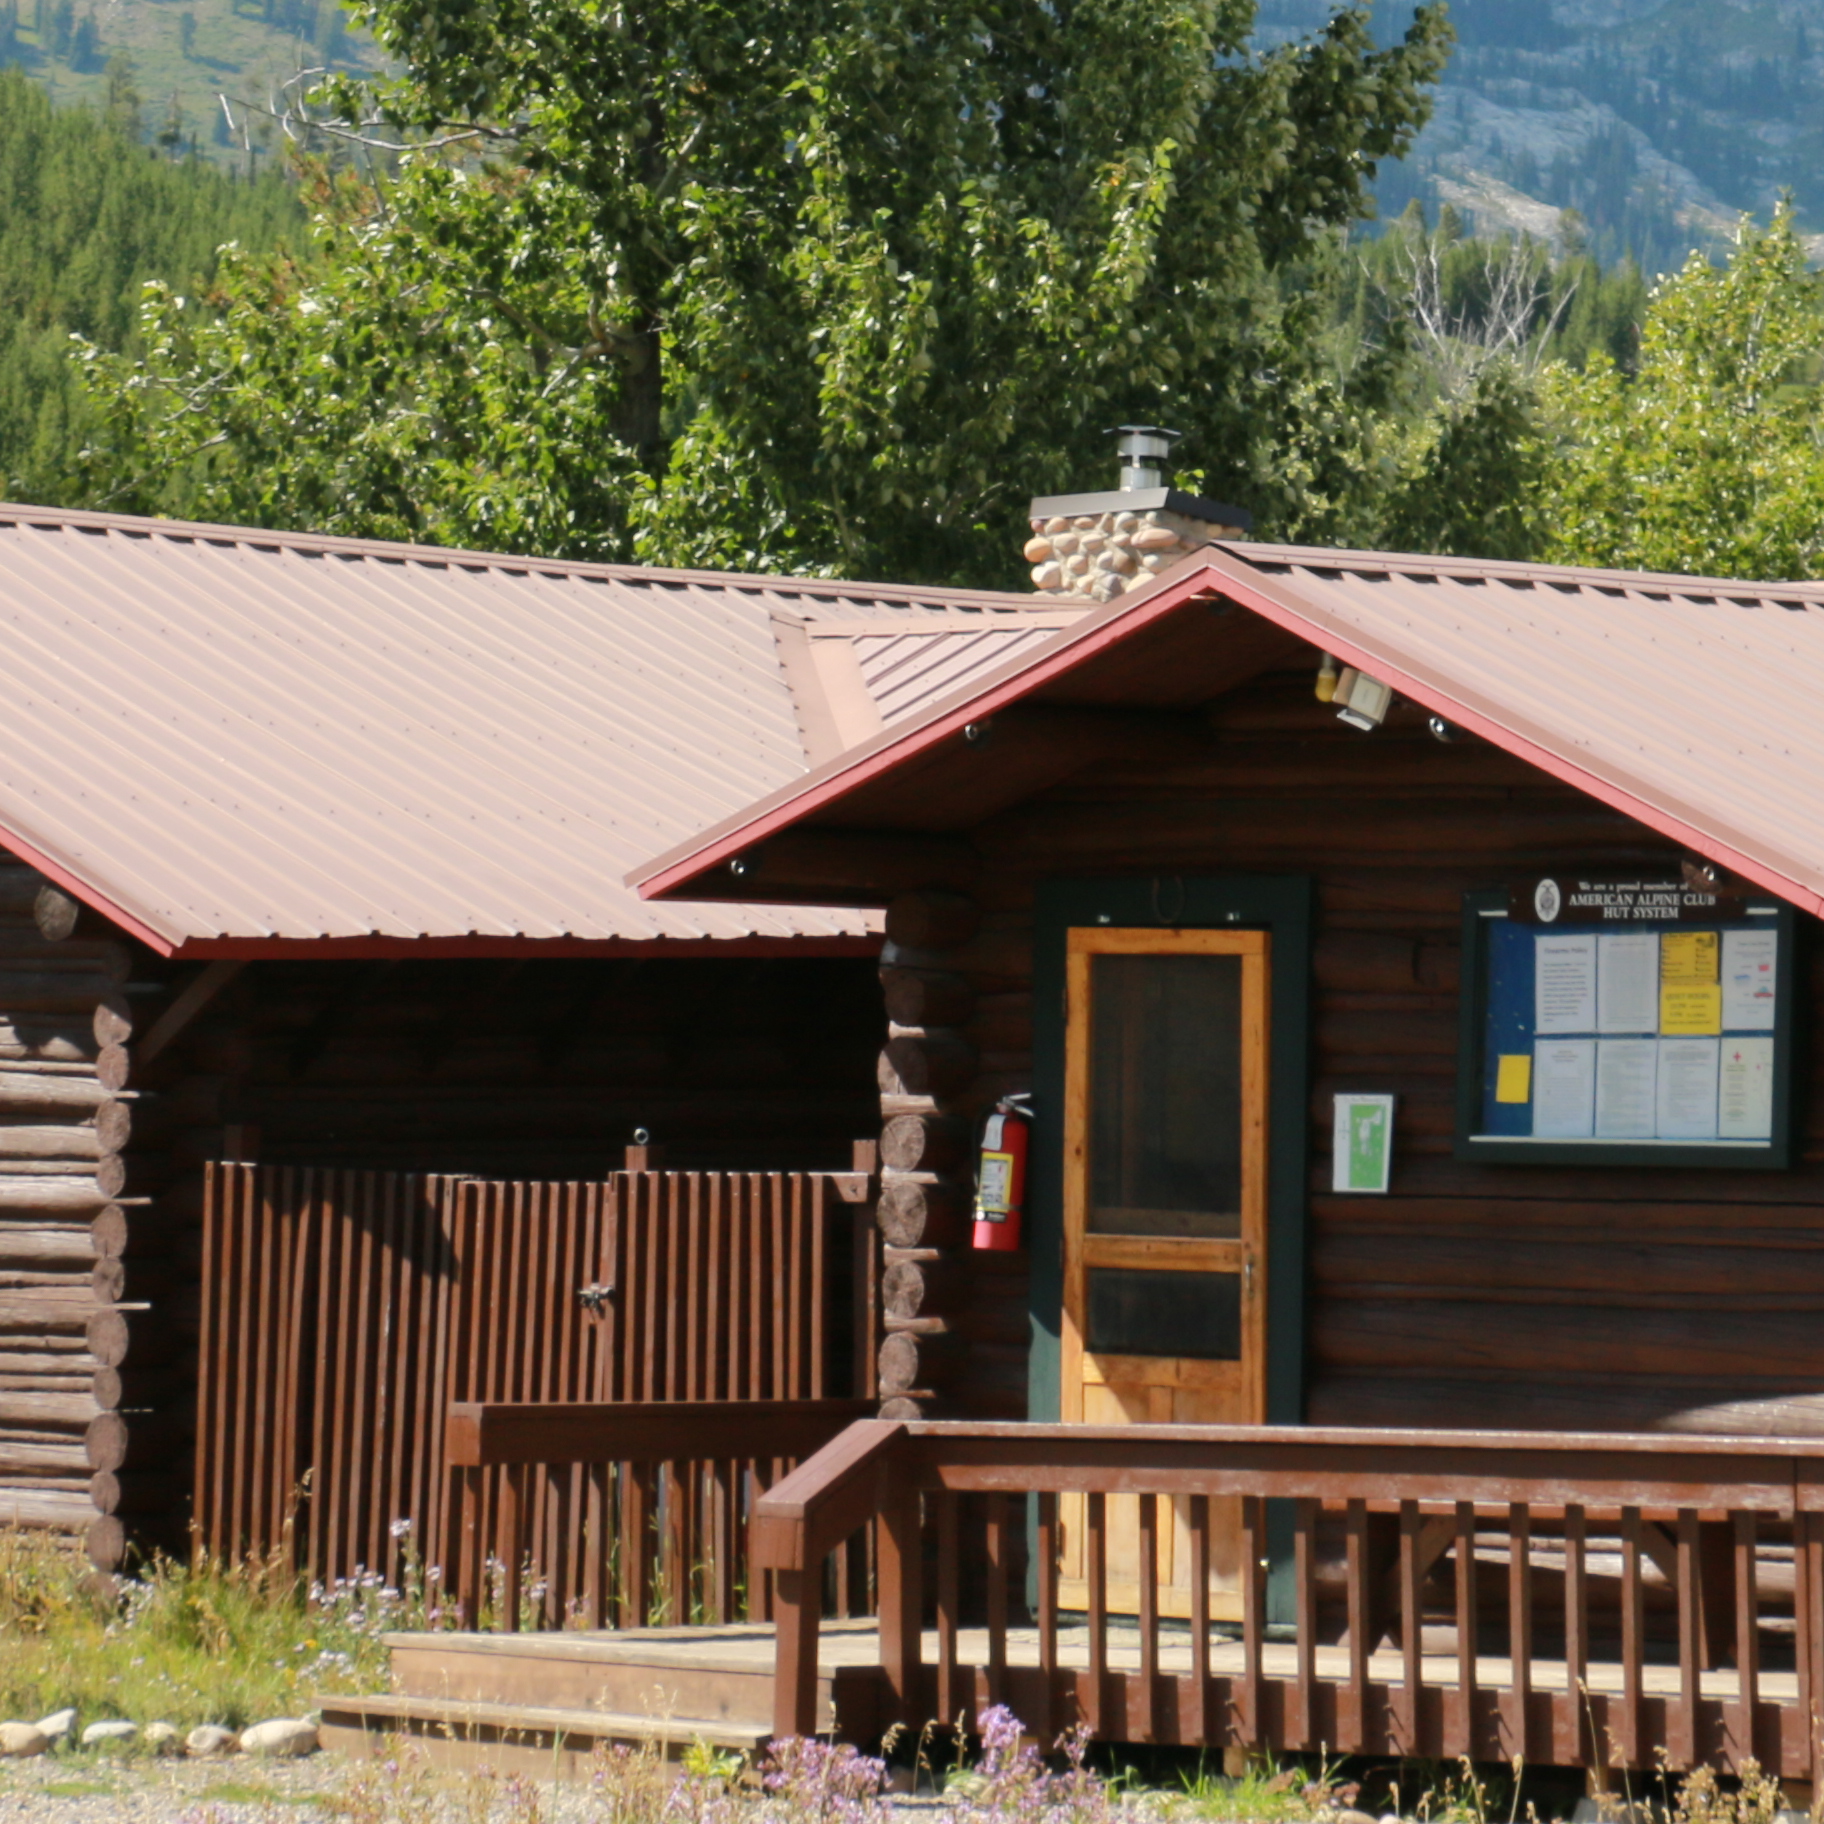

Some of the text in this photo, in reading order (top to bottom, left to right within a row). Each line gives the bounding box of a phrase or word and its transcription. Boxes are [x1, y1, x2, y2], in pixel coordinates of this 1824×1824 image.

[1578, 881, 1690, 894] We are a proud member of
[1569, 893, 1716, 906] AMERICAN ALPINE CLUB
[1603, 906, 1680, 919] HUT SYSTEM
